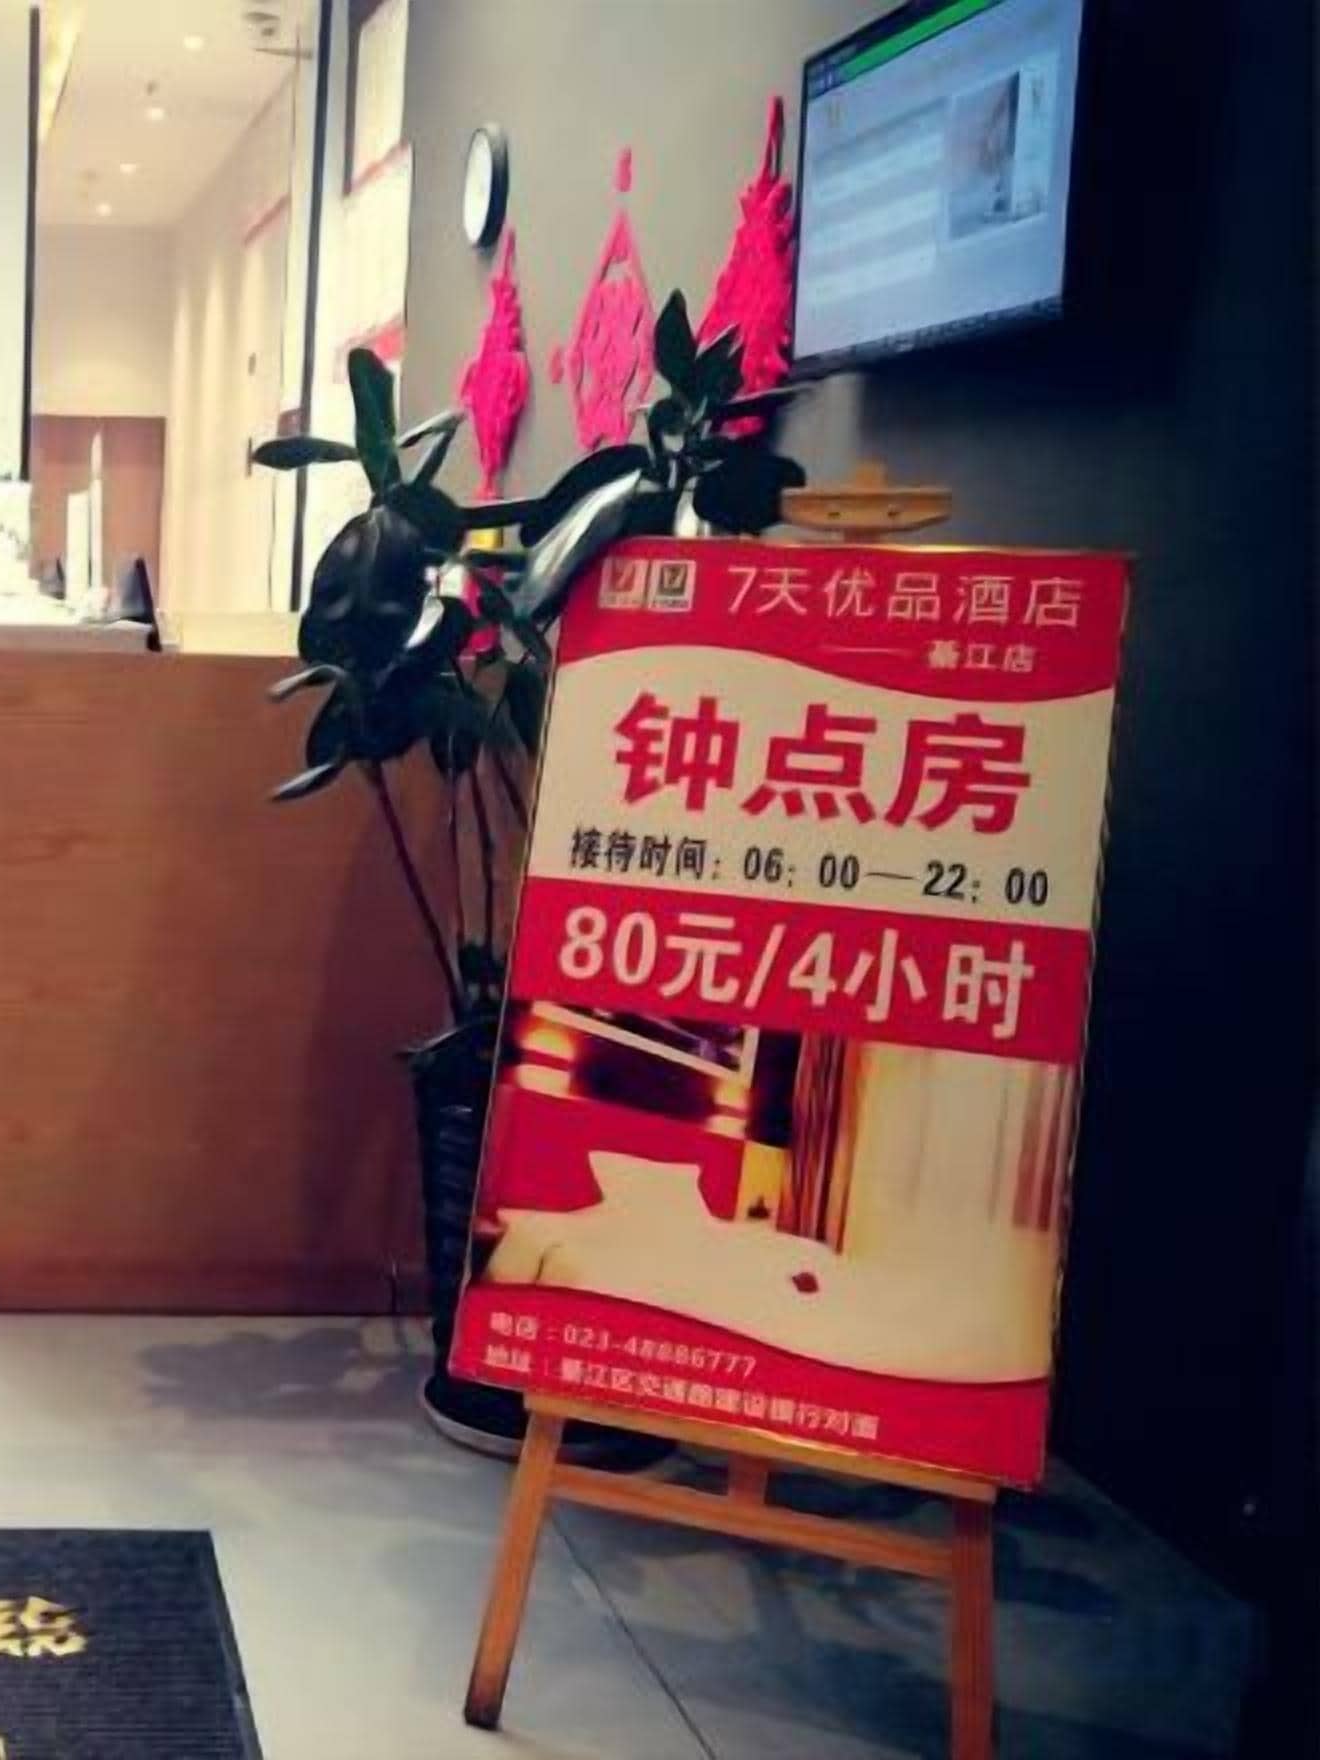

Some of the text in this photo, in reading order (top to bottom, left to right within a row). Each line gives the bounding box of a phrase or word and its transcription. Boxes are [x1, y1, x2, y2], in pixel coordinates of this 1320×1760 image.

[726, 566, 1085, 628] 7天优品酒店
[613, 692, 1032, 835] 钟点房
[557, 906, 1035, 1039] 80元/4小时
